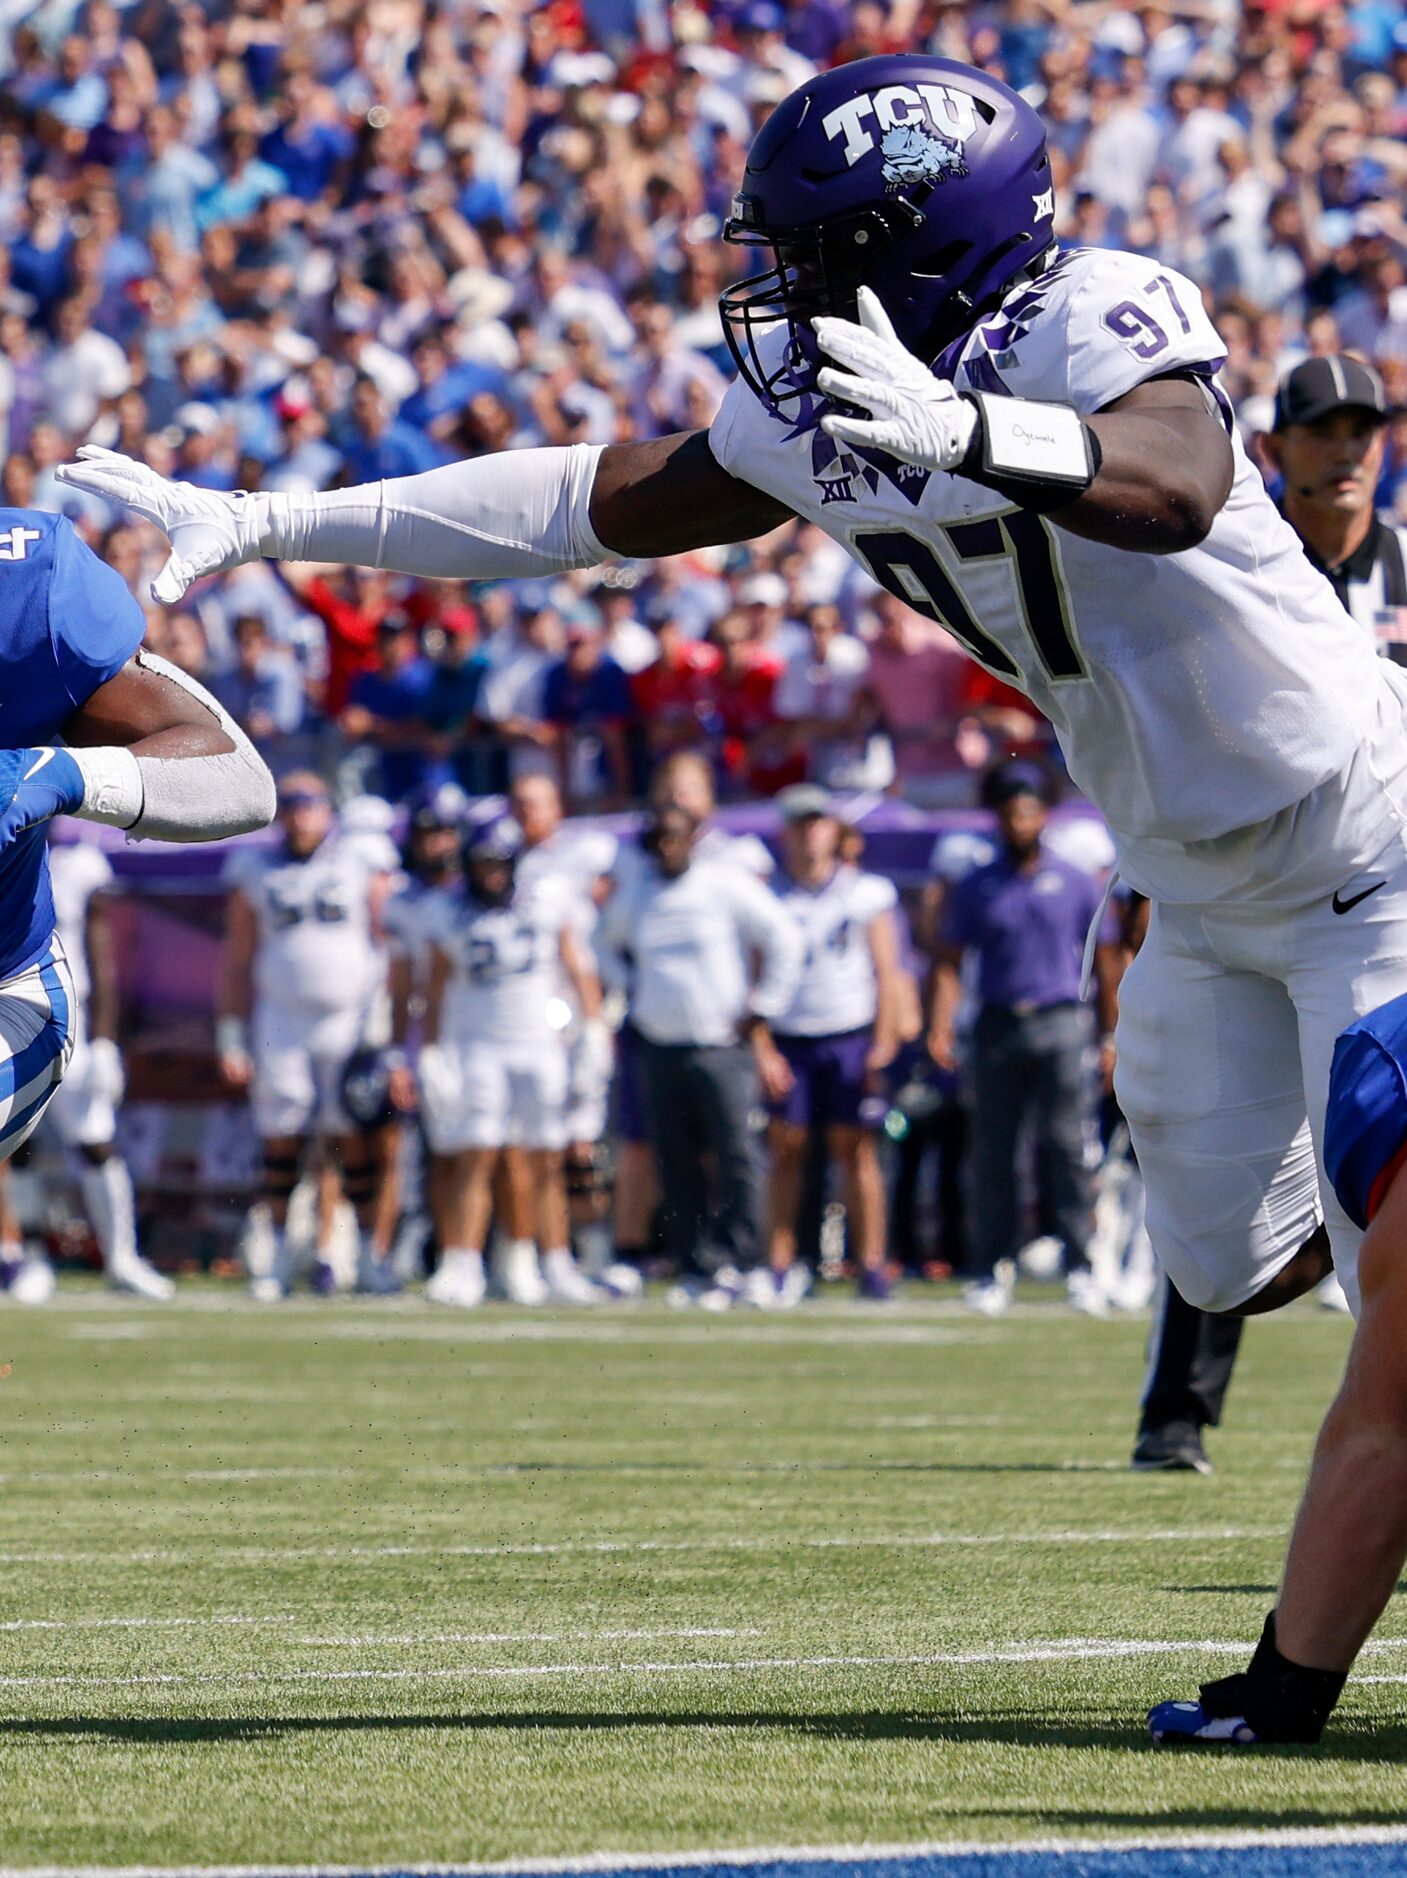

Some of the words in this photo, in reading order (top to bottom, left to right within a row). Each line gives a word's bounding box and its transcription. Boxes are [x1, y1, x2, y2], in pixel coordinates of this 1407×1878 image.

[821, 84, 978, 167] TCU
[1100, 274, 1191, 363] 97
[813, 473, 858, 506] XII
[897, 464, 925, 483] TCU
[850, 504, 1092, 682] 97
